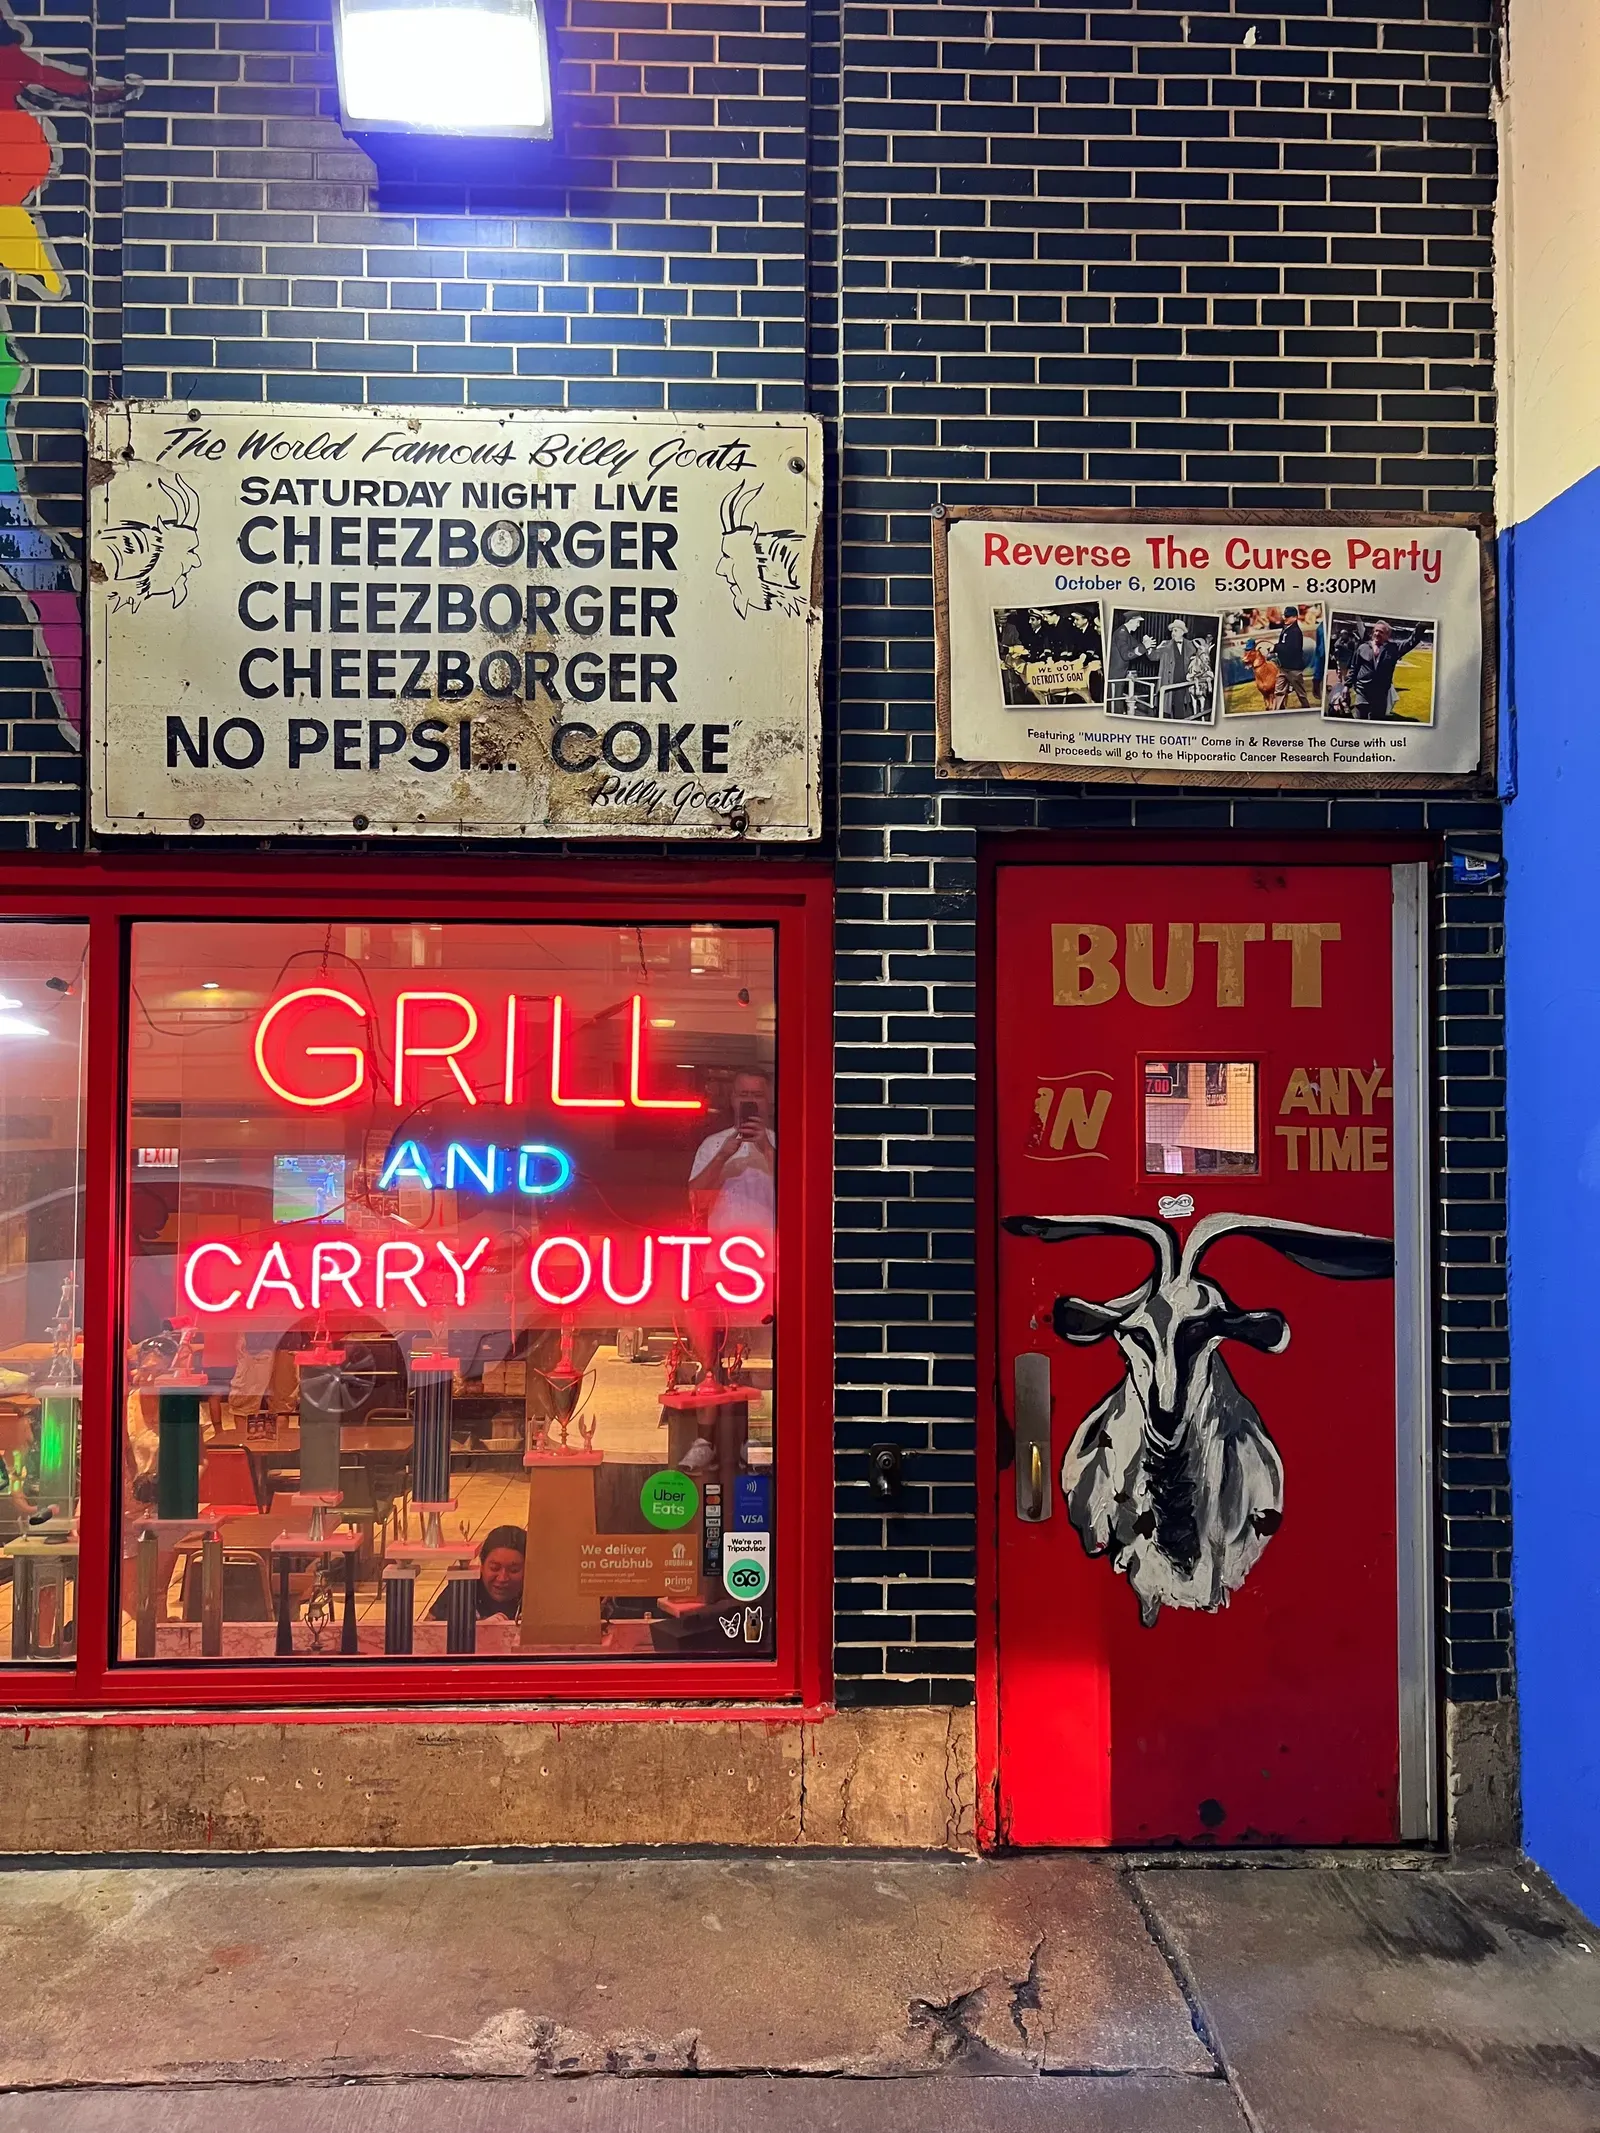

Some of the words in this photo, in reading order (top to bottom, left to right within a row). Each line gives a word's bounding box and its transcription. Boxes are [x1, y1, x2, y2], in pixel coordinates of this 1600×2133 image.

[156, 427, 227, 462] The
[237, 429, 358, 462] World
[362, 431, 517, 465] Famous
[528, 433, 639, 478] Billy
[646, 437, 757, 481] Goats
[239, 476, 451, 508] SATURDAY
[462, 482, 576, 510] NIGHT
[594, 484, 678, 513] LIVE
[238, 516, 678, 570] CHEEZBORGER
[984, 532, 1131, 567] Reverse
[1146, 535, 1209, 569] The
[1225, 538, 1331, 570] Curse
[1347, 539, 1442, 583] Party
[1054, 575, 1123, 592] October
[1128, 576, 1147, 595] 6,
[1153, 577, 1196, 592] 2016
[1214, 578, 1286, 593] 5:30PM
[1306, 579, 1377, 595] 8:30PM
[238, 581, 678, 638] CHEEZBORGER
[238, 647, 678, 703] CHEEZBORGER
[1038, 666, 1052, 674] WE
[1066, 672, 1084, 682] GOAT
[166, 715, 265, 770] NO
[288, 718, 517, 772] PEPSI...
[1027, 728, 1075, 744] Featuring
[1078, 731, 1132, 744] "MURPHY
[1136, 735, 1155, 744] THE
[1159, 736, 1197, 746] GOAT!"
[1201, 736, 1232, 747] Come
[1235, 737, 1245, 747] in
[1249, 737, 1258, 747] &
[1262, 737, 1304, 748] Reverse
[1308, 738, 1326, 748] The
[1330, 738, 1360, 748] Curse
[1363, 738, 1386, 748] with
[1390, 737, 1407, 748] us!
[1038, 743, 1051, 754] All
[1055, 747, 1102, 757] proceeds
[1105, 748, 1122, 758] will
[1125, 751, 1138, 761] go
[1142, 749, 1153, 759] to
[1156, 750, 1174, 760] the
[1176, 750, 1236, 763] Hippocratic
[1240, 751, 1277, 762] Cancer
[1280, 752, 1329, 762] Research
[1333, 752, 1396, 763] Foundation.
[590, 776, 667, 816] Billy
[673, 781, 745, 824] Goats
[1051, 923, 1342, 1007] BUTT
[253, 987, 703, 1109] GRILL
[1279, 1067, 1393, 1115] ANY-
[144, 1148, 172, 1163] EXIT
[1275, 1126, 1388, 1171] TIME
[377, 1140, 575, 1195] AND
[183, 1236, 491, 1313] CARRY
[530, 1236, 766, 1306] OUTS
[653, 1489, 686, 1502] Uber
[652, 1502, 685, 1516] Eats
[741, 1515, 764, 1524] VISA
[581, 1544, 602, 1555] We
[605, 1543, 647, 1555] deliver
[727, 1545, 767, 1553] Tripadvisor
[731, 1538, 752, 1546] We're
[580, 1560, 596, 1569] on
[600, 1558, 653, 1569] Grubhub
[664, 1559, 693, 1567] GRUBHUB
[664, 1576, 693, 1587] prime
